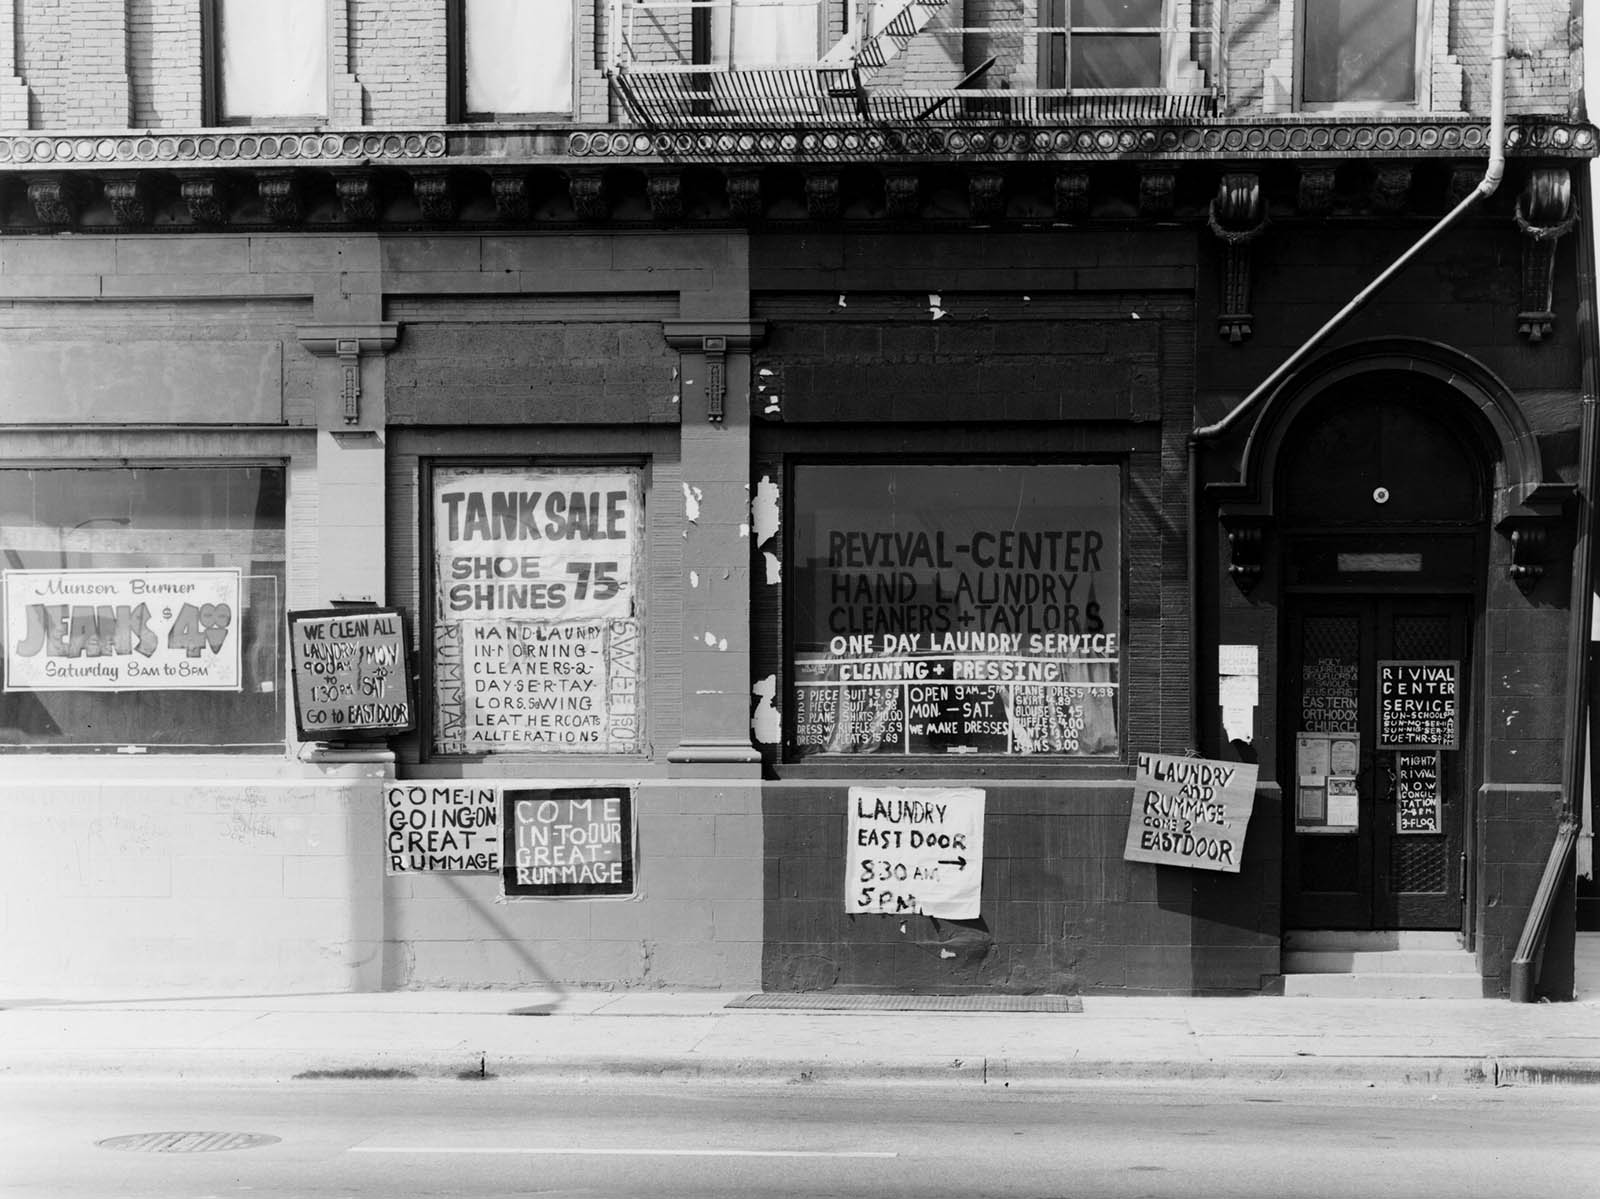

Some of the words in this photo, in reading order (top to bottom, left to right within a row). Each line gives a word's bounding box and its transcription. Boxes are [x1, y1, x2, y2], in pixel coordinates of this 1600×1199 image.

[441, 491, 542, 541] TANK
[545, 491, 627, 541] SALE
[452, 556, 540, 579] SHOE
[35, 579, 119, 596] Munson
[129, 579, 195, 595] Burner
[831, 572, 917, 603] HAND
[935, 571, 1078, 604] LAUNDRY
[450, 583, 566, 611] SHINES
[829, 604, 951, 633] CLEANERS
[16, 602, 158, 658] JEANS
[304, 624, 325, 640] WE
[330, 619, 369, 640] CLEAN
[374, 618, 396, 635] ALL
[830, 635, 874, 655] ONE
[883, 633, 921, 653] DAY
[930, 631, 1022, 653] LAUNDRY
[1029, 633, 1116, 654] SERVICE
[303, 643, 356, 665] LAUNDRY
[366, 644, 398, 665] MON
[1318, 657, 1341, 666] HOLY
[45, 661, 119, 681] Saturday
[840, 662, 929, 680] CLEANING
[953, 661, 1059, 681] PRESSING
[363, 676, 384, 698] SAT
[910, 687, 948, 702] OPEN
[1052, 687, 1084, 698] DRESS
[1383, 682, 1455, 695] CENTER
[797, 690, 805, 701] 3
[809, 690, 839, 701] PIECE
[843, 690, 867, 700] SUIT
[1016, 696, 1044, 706] SKIRT
[1303, 697, 1358, 709] EASTERN
[798, 702, 805, 712] 2
[809, 701, 836, 712] PIECE
[843, 701, 866, 712] SUIT
[963, 702, 993, 718] SAT.
[1015, 706, 1049, 718] BLOUSE
[1383, 699, 1454, 711] SERVICE
[307, 709, 327, 724] GO
[809, 712, 835, 723] PLANE
[843, 712, 874, 722] SHIRTS
[1303, 709, 1358, 721] ORTHODOX
[797, 724, 823, 735] DRESS
[909, 724, 923, 735] WE
[926, 722, 958, 735] MAKE
[964, 722, 1009, 735] DRESSES
[1305, 721, 1357, 733] CHURCH
[797, 735, 823, 745] DRESS
[1154, 760, 1234, 787] LAUNDRY
[1401, 781, 1437, 792] NOW
[517, 798, 621, 824] COME
[858, 797, 947, 824] LAUNDRY
[1143, 816, 1177, 831] COME
[858, 828, 902, 849] EAST
[910, 830, 967, 850] DOOR
[391, 854, 498, 871] RUMMAGE
[517, 862, 622, 885] RUMMAGE
